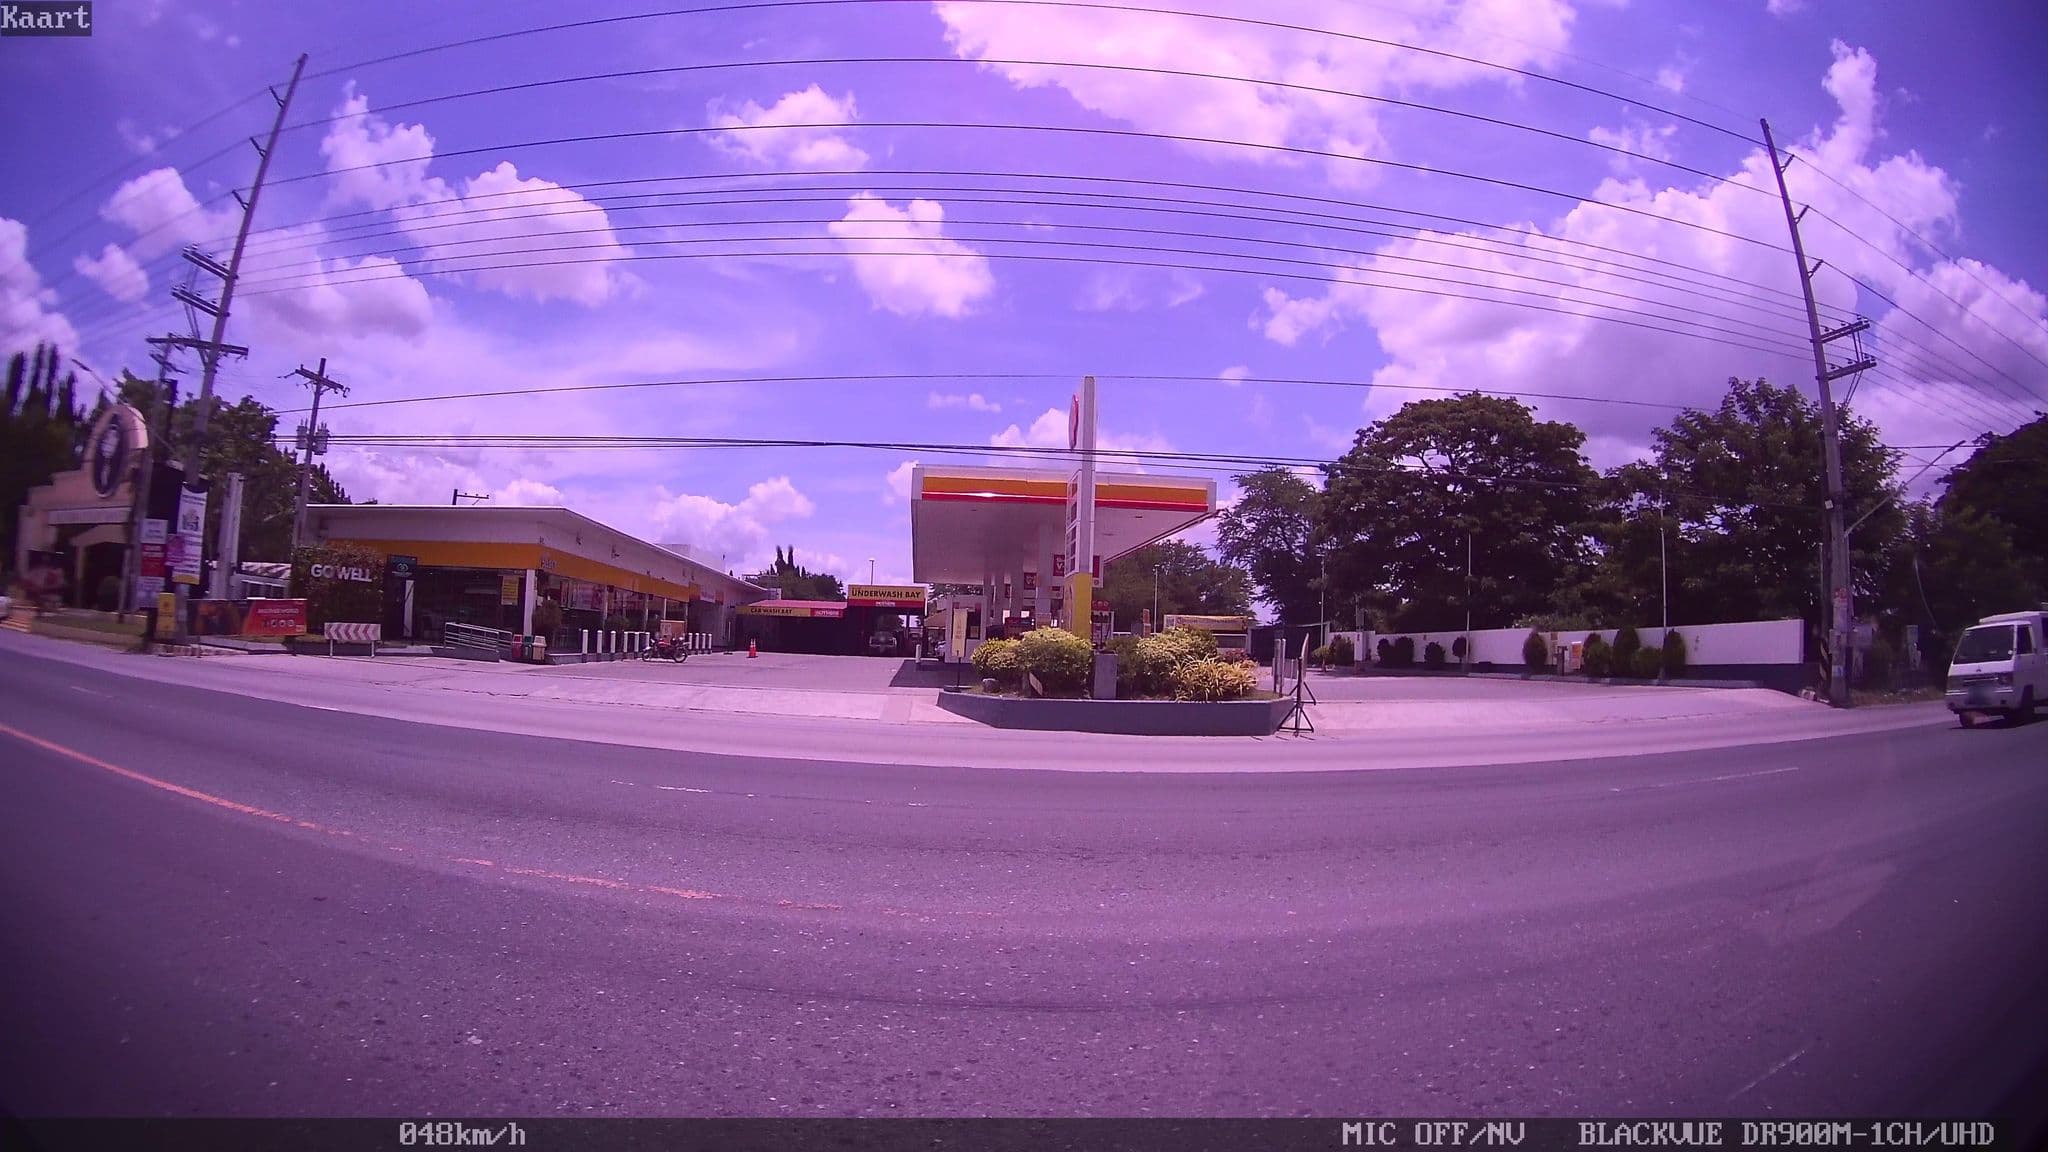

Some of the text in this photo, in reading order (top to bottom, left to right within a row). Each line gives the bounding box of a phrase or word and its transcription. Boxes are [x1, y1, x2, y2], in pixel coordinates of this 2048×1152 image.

[310, 563, 373, 582] GO WELL
[851, 588, 903, 598] UNDERWASH
